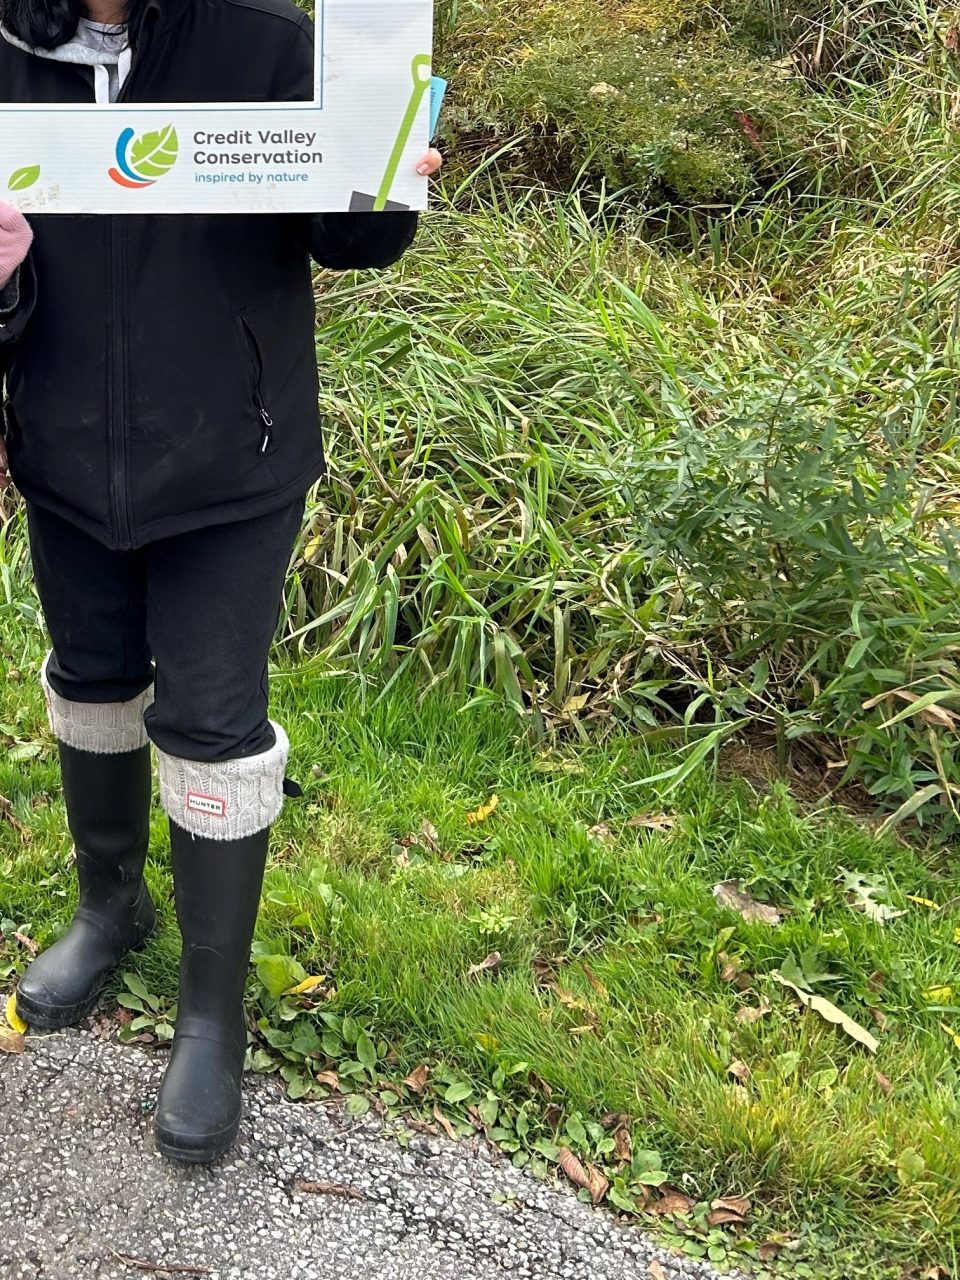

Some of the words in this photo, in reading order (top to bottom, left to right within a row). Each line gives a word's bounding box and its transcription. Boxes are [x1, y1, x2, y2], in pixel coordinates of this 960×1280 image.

[193, 130, 253, 145] Credit
[257, 129, 316, 147] Valley
[193, 150, 323, 165] Conservation
[194, 172, 245, 184] inspired
[248, 172, 263, 185] by
[267, 173, 309, 183] nature
[190, 799, 221, 810] HUNTER
